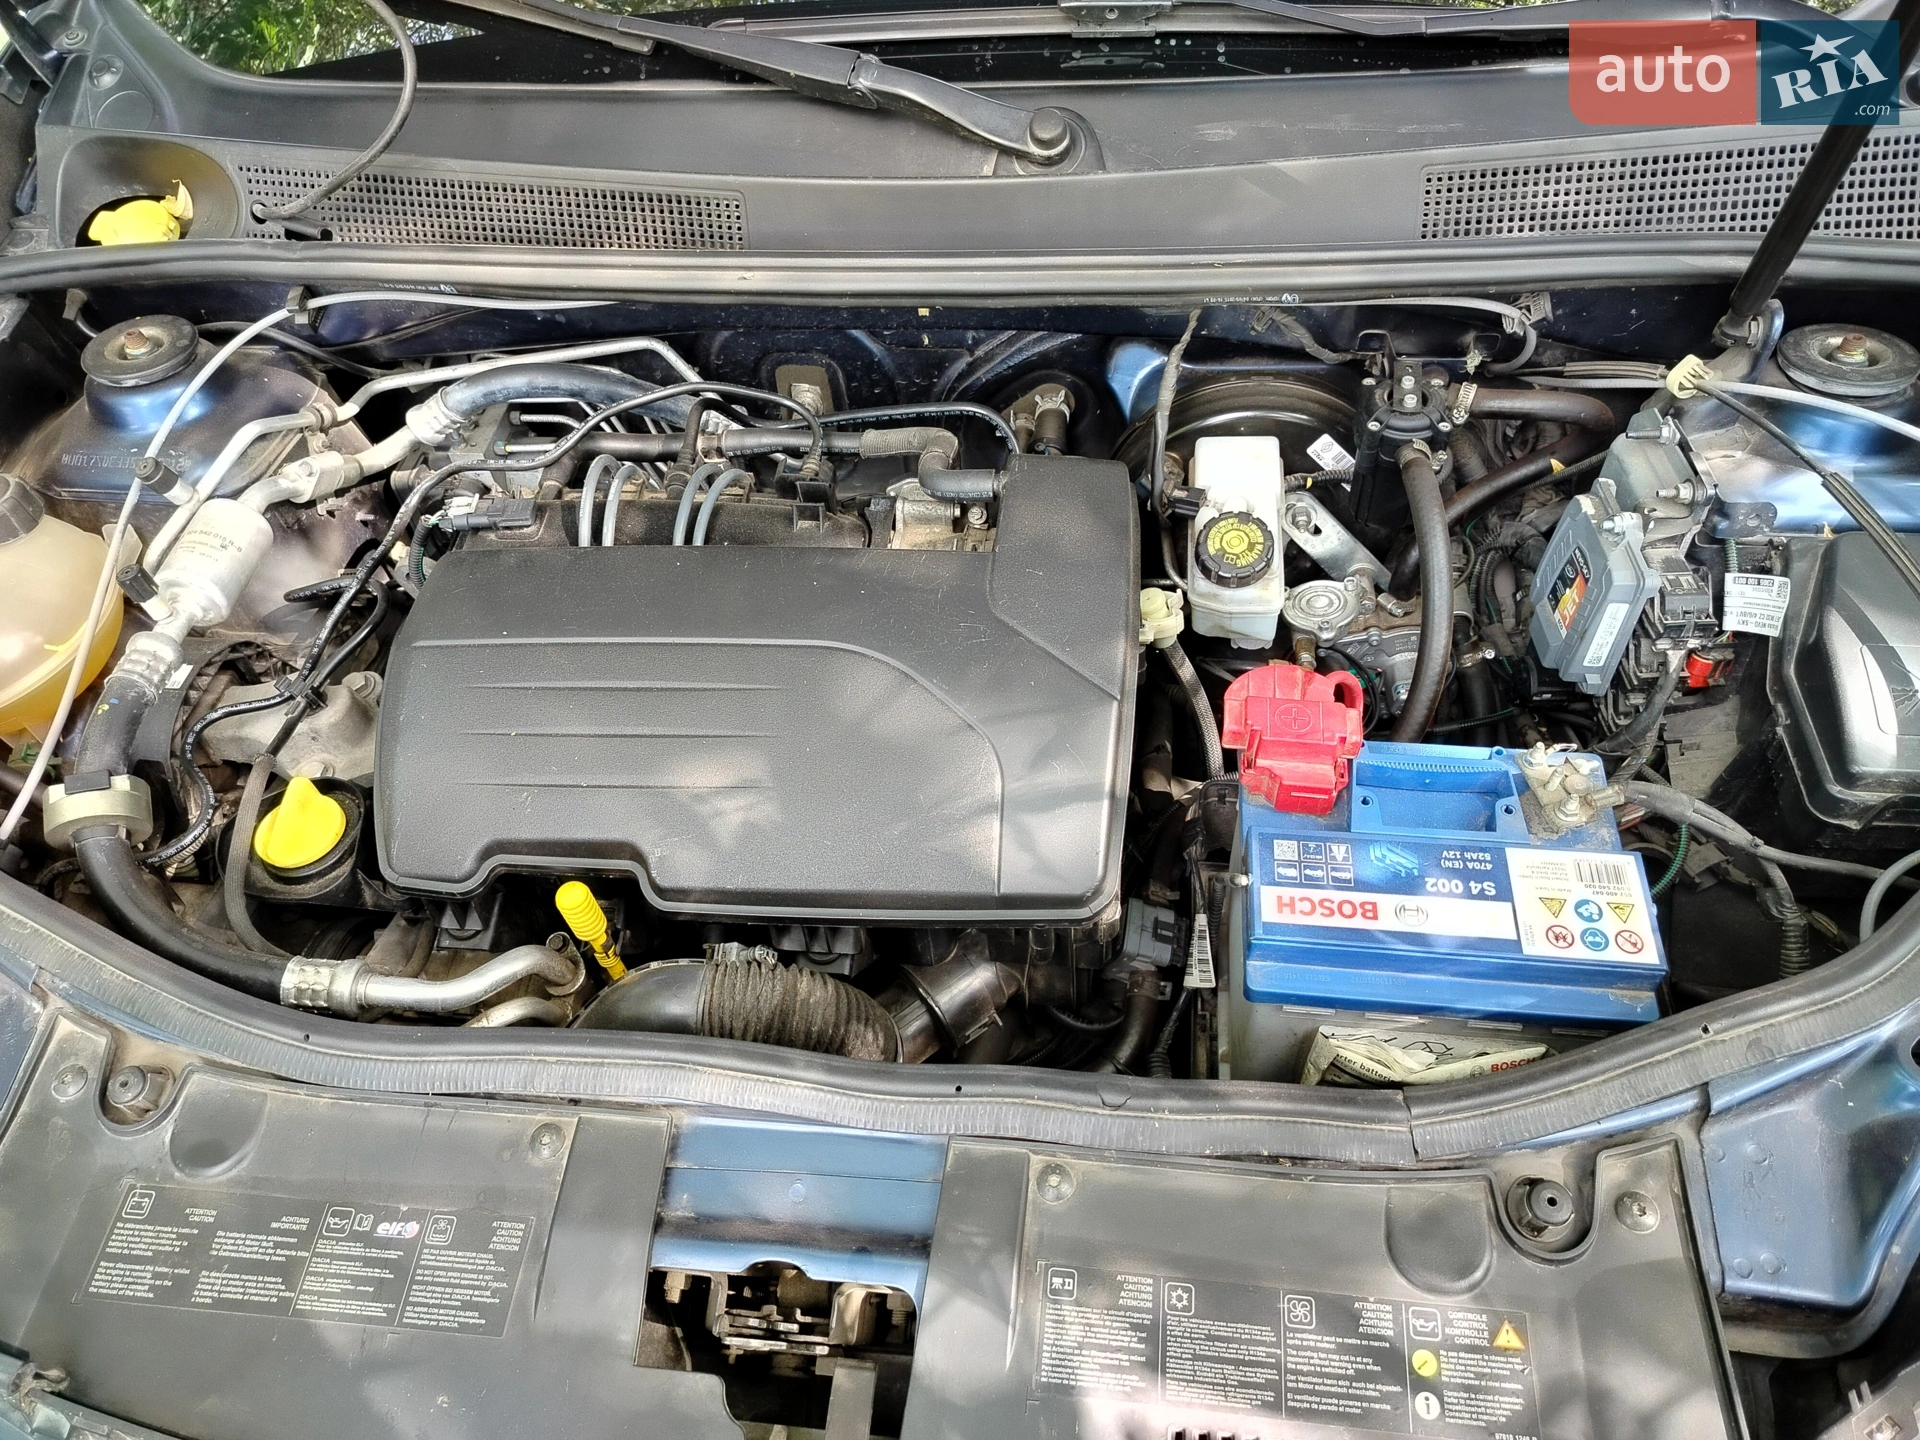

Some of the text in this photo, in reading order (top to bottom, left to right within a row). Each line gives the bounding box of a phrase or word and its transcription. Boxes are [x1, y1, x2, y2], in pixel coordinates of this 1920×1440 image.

[1563, 588, 1580, 626] JET
[1442, 850, 1491, 860] 52Ah 12V
[1440, 859, 1493, 870] 470A (EN)
[1424, 878, 1496, 896] S4 002
[1276, 896, 1378, 921] BOSCH
[184, 1207, 217, 1216] ATTENTION
[280, 1215, 310, 1223] ACHTUNG
[270, 1222, 307, 1230] IMPORTANTE
[491, 1220, 525, 1229] ATTENTION
[491, 1235, 521, 1244] ACHTUNG
[488, 1242, 519, 1251] ATENCION
[1116, 1274, 1152, 1284] ATTENTION
[1123, 1283, 1152, 1291] CAUTION
[1120, 1290, 1152, 1299] ACHTUNG
[1118, 1298, 1152, 1307] ATENCION
[1354, 1301, 1391, 1311] ATTENTION
[1361, 1310, 1392, 1319] CAUTION
[1447, 1311, 1487, 1321] CONTROLE
[1359, 1318, 1392, 1327] ACHTUNG
[1453, 1319, 1488, 1329] CONTROL
[1358, 1326, 1393, 1335] ATENCION
[1444, 1327, 1488, 1338] KONTROLLE
[1294, 1332, 1322, 1340] ventilateur
[1454, 1336, 1489, 1346] CONTROL
[1297, 1350, 1317, 1358] cooling
[1330, 1360, 1351, 1368] warning
[1297, 1375, 1322, 1383] Ventilator
[1443, 1389, 1468, 1398] Consulter
[1294, 1393, 1320, 1402] ventilador
[1321, 1396, 1338, 1405] puede
[1339, 1398, 1360, 1407] ponerse
[1370, 1401, 1390, 1409] marcha
[1466, 1399, 1499, 1407] maintenance
[1287, 1400, 1310, 1409] después
[1319, 1403, 1337, 1412] parado
